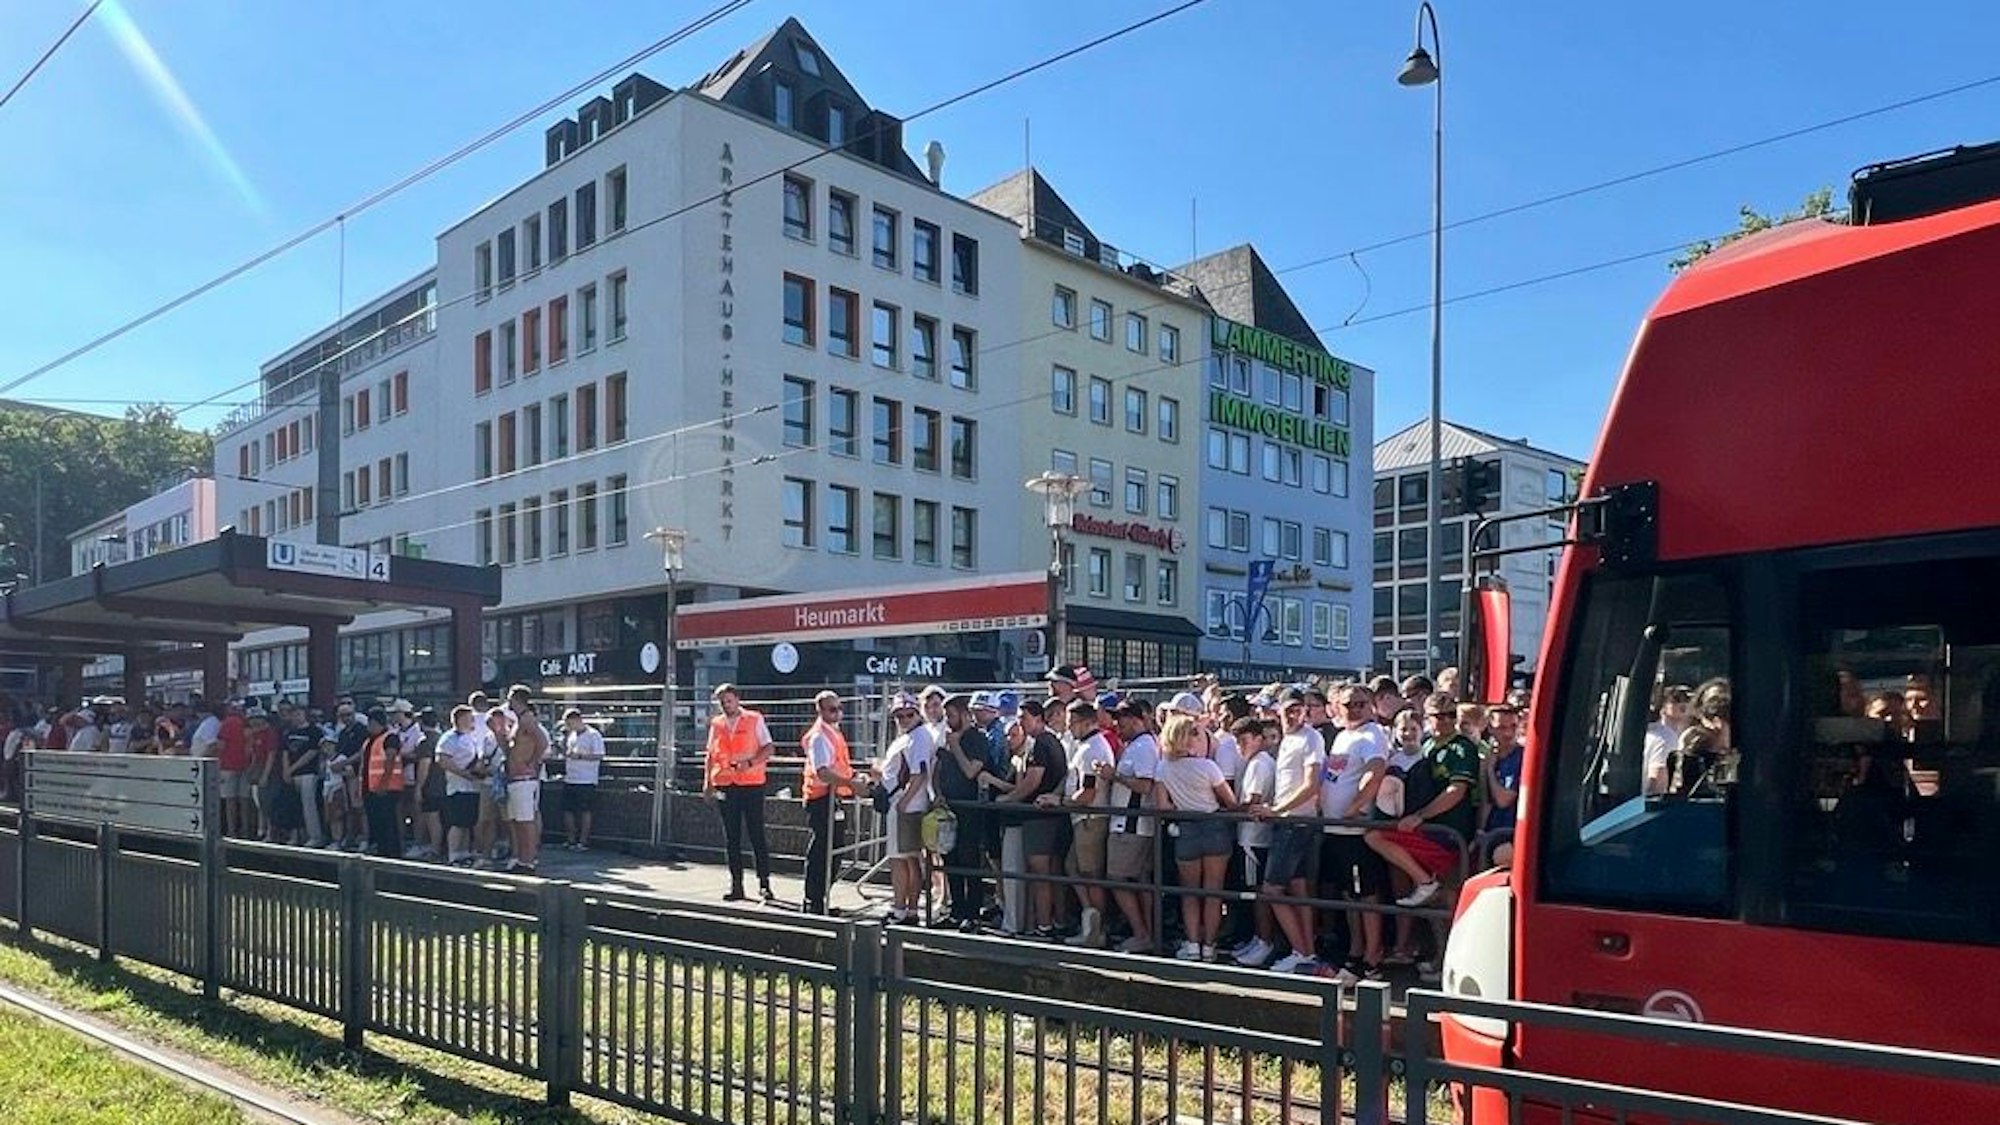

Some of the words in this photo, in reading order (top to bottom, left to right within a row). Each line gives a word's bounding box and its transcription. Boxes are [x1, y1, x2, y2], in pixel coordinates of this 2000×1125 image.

[1210, 315, 1351, 389] LAMMERTING
[1210, 391, 1350, 458] IMMOBILIEN
[372, 562, 385, 578] 4
[795, 602, 886, 627] Heumarkt
[540, 659, 561, 676] Café
[567, 653, 597, 674] ART
[866, 655, 898, 675] Café
[906, 655, 947, 677] ART
[1220, 667, 1284, 682] RESTURANT
